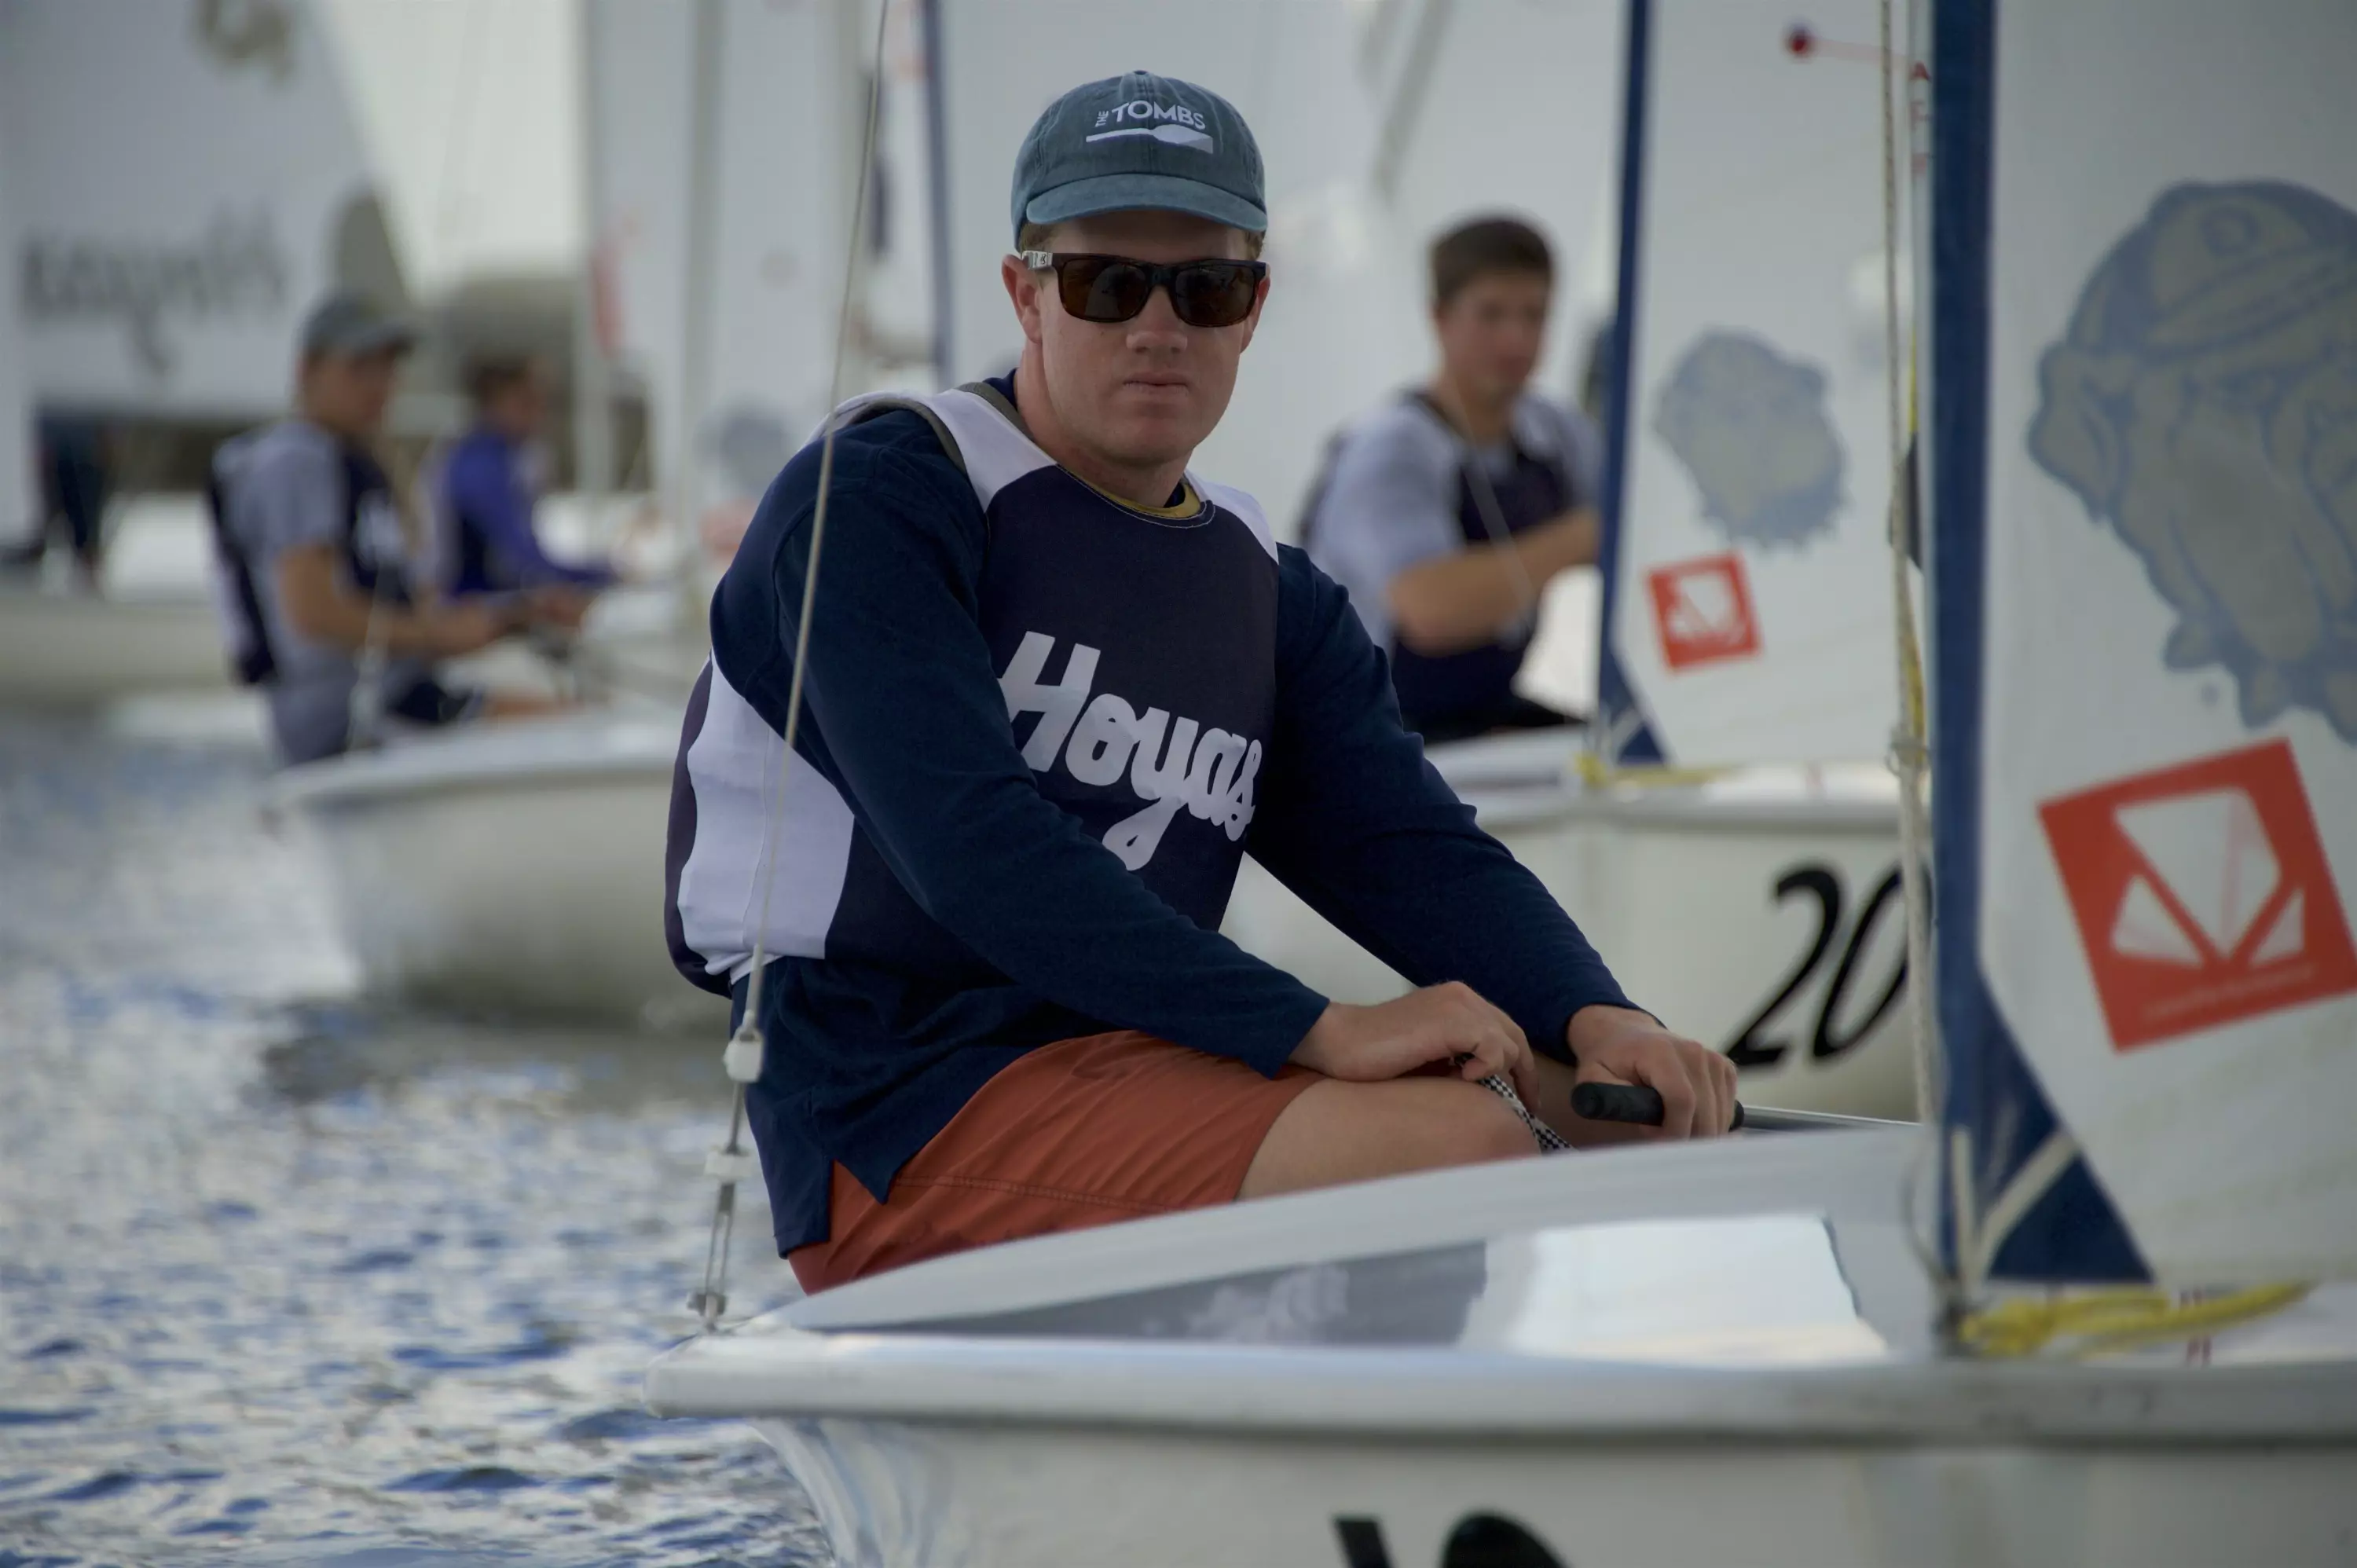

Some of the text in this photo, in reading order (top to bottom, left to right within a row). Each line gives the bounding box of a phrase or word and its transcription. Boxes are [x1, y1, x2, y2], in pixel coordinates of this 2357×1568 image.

[1094, 100, 1206, 130] THE TOMBS
[997, 631, 1262, 871] Hoyas
